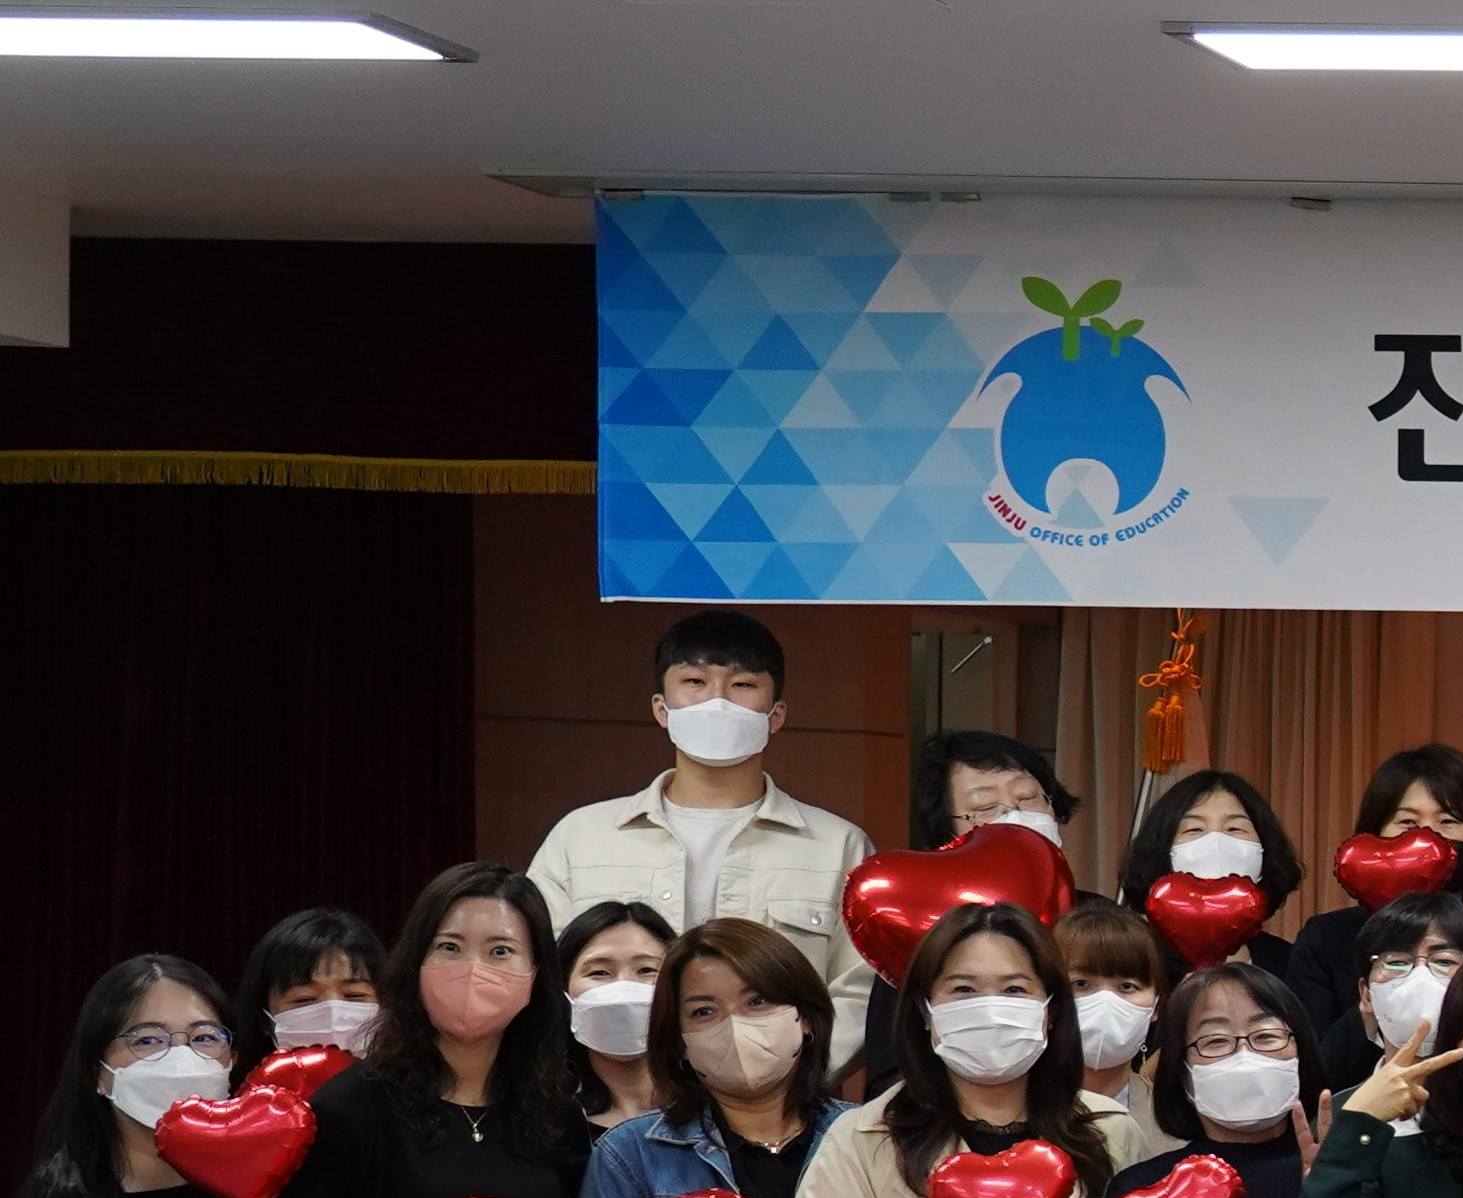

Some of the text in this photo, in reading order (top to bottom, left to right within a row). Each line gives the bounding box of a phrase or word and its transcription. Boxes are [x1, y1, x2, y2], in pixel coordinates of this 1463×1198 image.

[988, 487, 1190, 547] JINJU OFFICE OF EDUCATION
